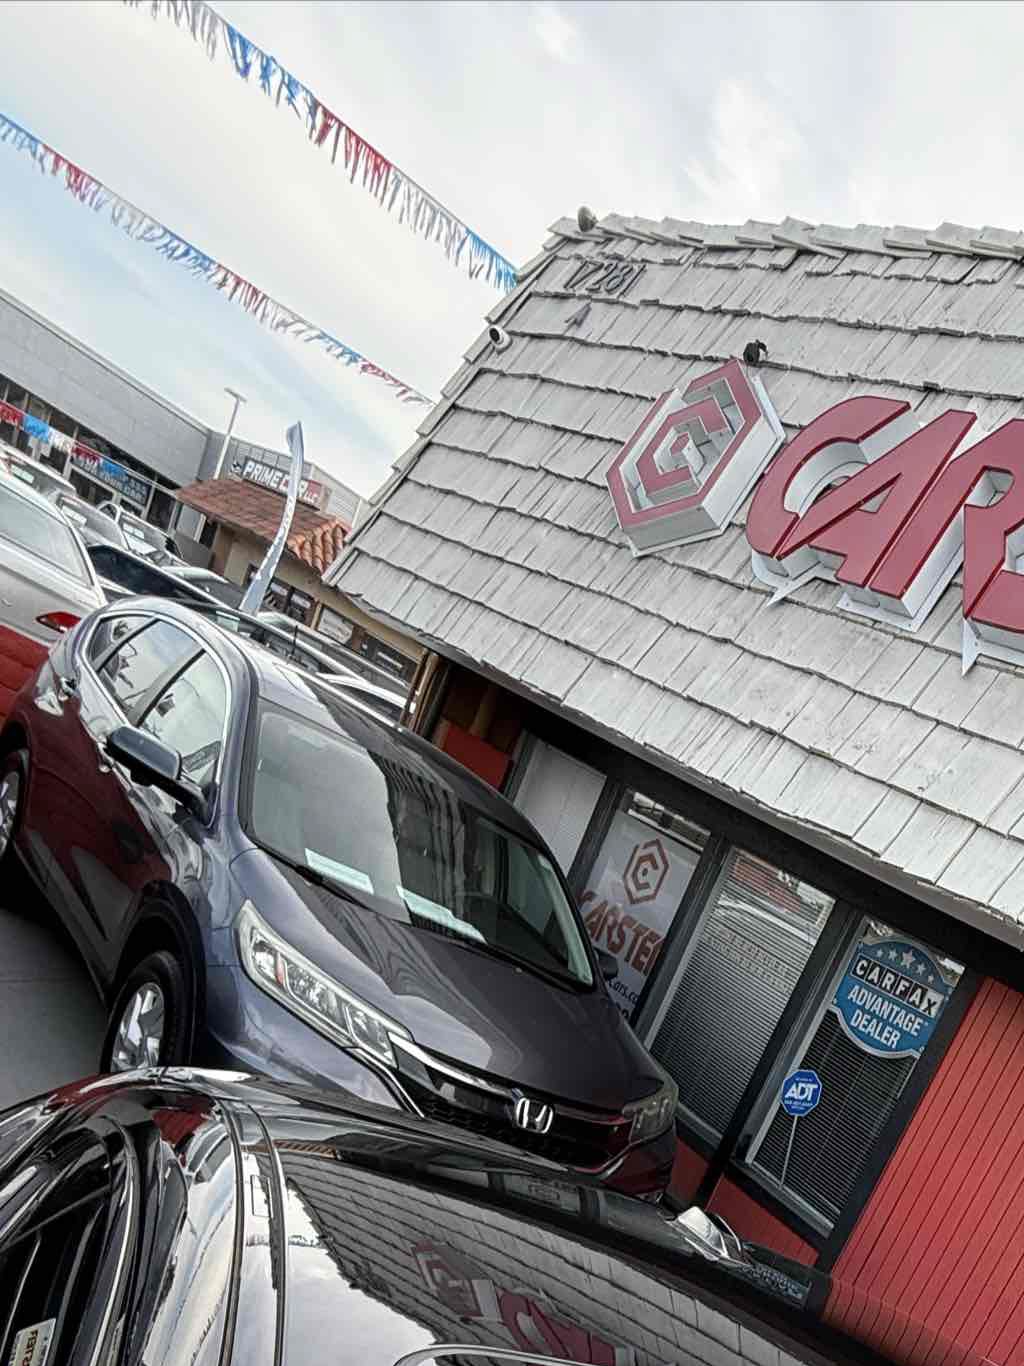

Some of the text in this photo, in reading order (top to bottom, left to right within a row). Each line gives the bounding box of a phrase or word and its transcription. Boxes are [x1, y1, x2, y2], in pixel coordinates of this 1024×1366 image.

[563, 260, 647, 299] 17281
[243, 460, 282, 488] PRIME
[855, 959, 938, 1016] CARFAX
[847, 985, 923, 1036] ADVANTAGE
[850, 1009, 901, 1049] DEALER
[784, 1082, 818, 1101] ADT
